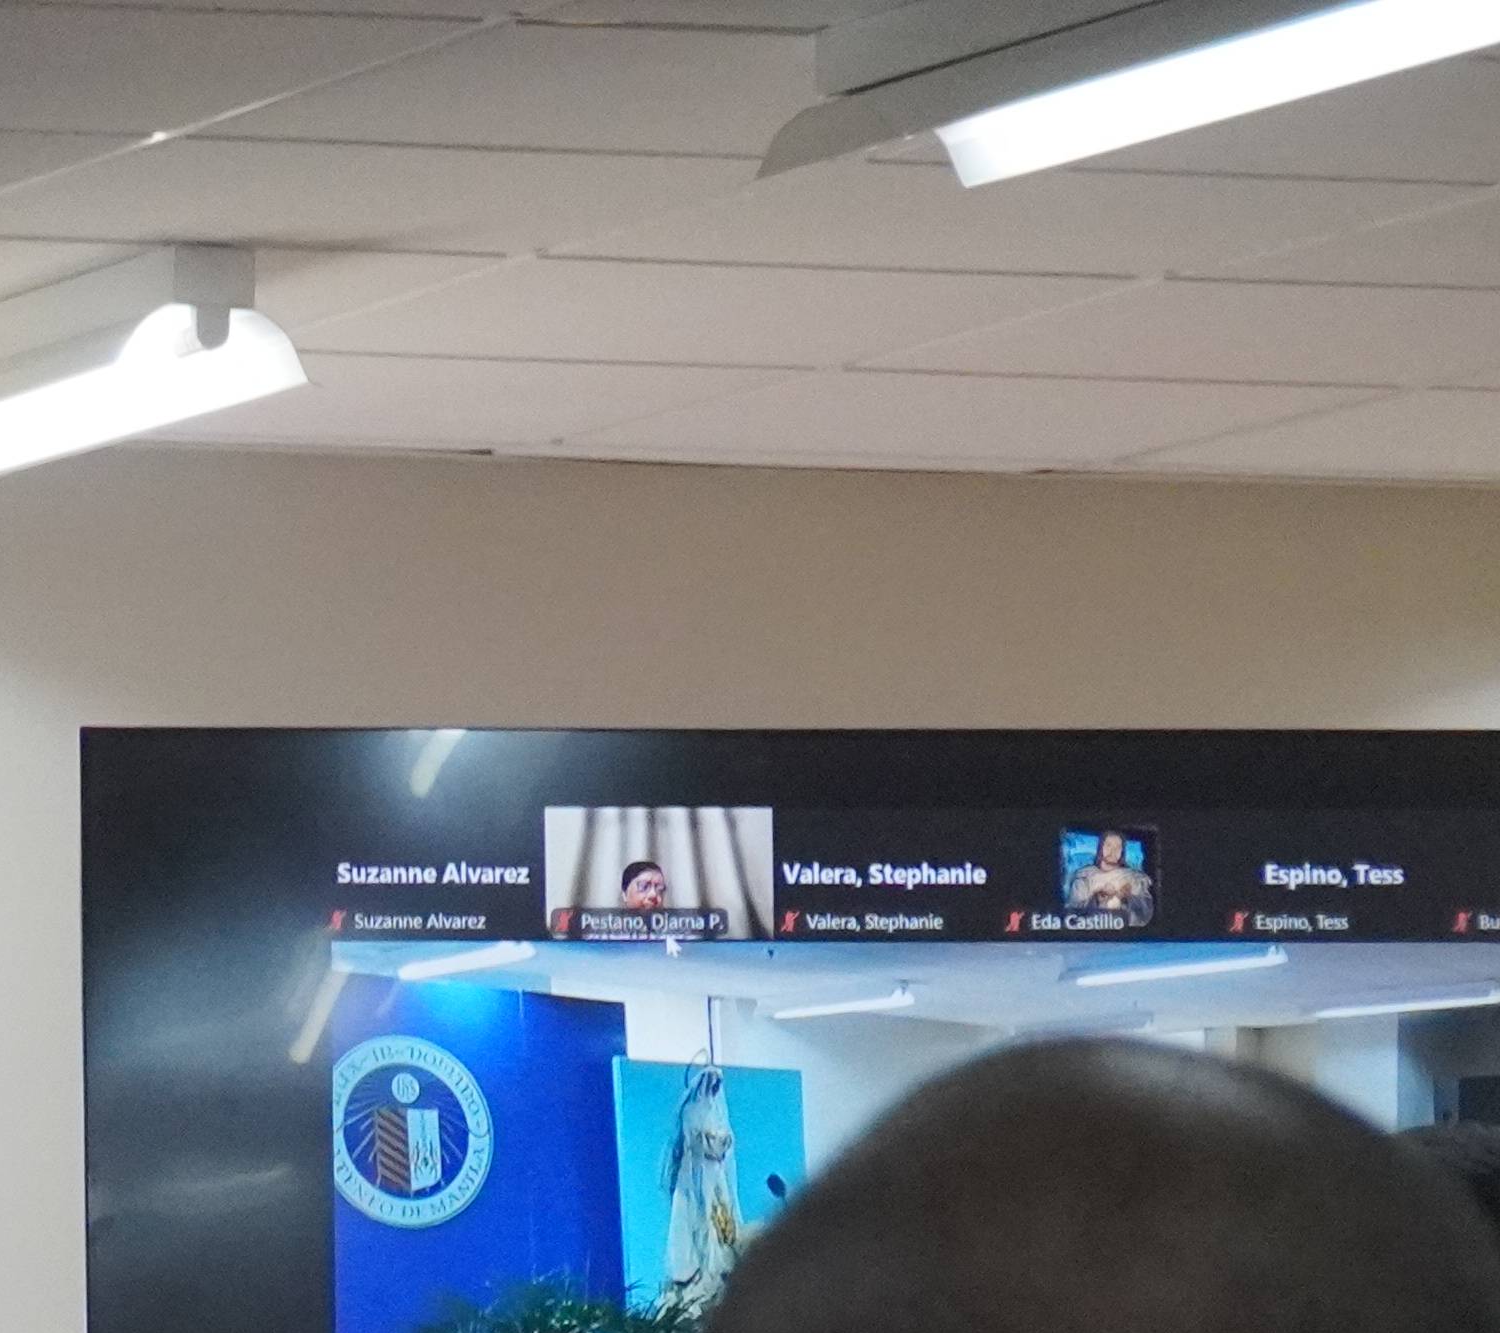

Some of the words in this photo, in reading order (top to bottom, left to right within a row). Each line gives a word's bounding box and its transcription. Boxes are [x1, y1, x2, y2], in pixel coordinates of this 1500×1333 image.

[336, 861, 437, 886] Suzanne
[441, 860, 530, 886] Alvarez
[782, 861, 863, 889] Valera,
[868, 860, 987, 891] Stephanie
[1263, 861, 1349, 890] Espino,
[1352, 863, 1405, 886] Tess
[353, 912, 423, 931] Suzanne
[427, 912, 487, 931] Alvarez
[805, 912, 860, 932] Valera,
[864, 912, 944, 933] Stephanie
[1030, 913, 1061, 931] Eda
[1065, 913, 1124, 931] Castillo
[1254, 913, 1313, 933] Espino,
[1315, 914, 1349, 931] Tess
